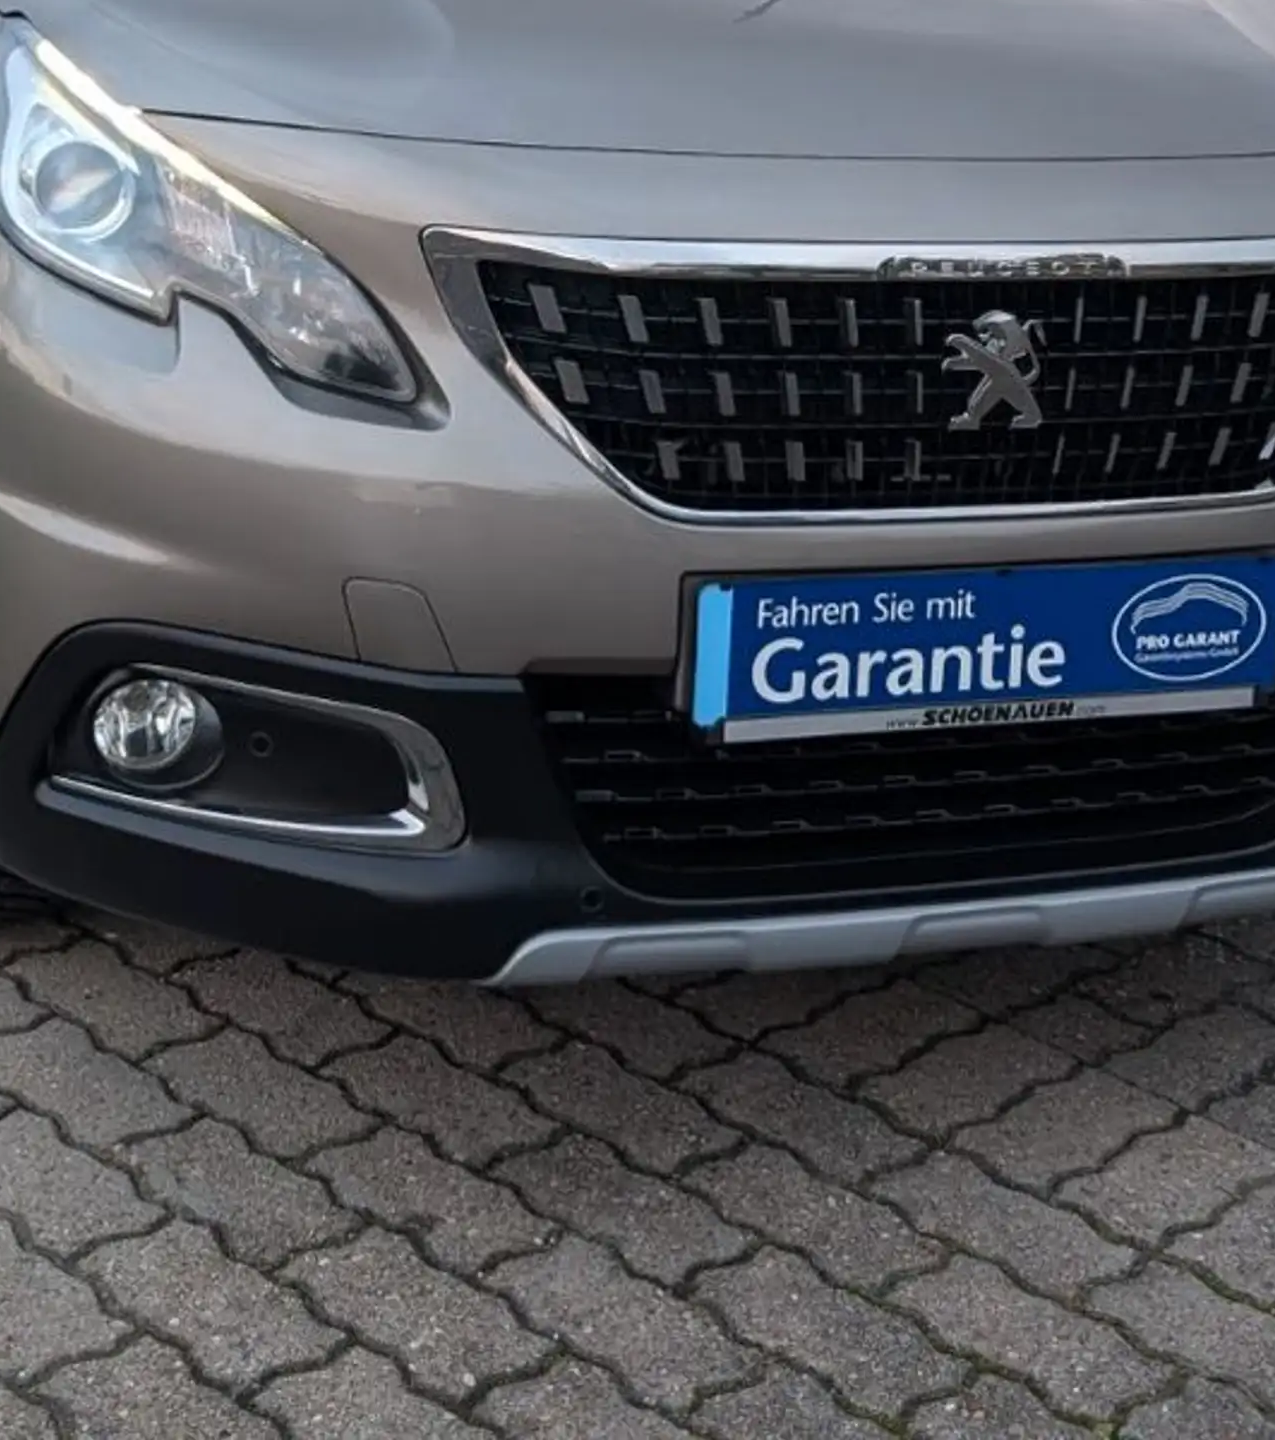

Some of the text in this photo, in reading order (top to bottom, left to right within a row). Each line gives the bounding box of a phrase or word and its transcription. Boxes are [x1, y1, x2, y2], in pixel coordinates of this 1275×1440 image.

[909, 259, 1099, 278] PEUGEOT
[757, 591, 975, 629] Fahren Sie mit
[1135, 629, 1240, 651] PRO GARANT
[751, 624, 1066, 704] Garantie
